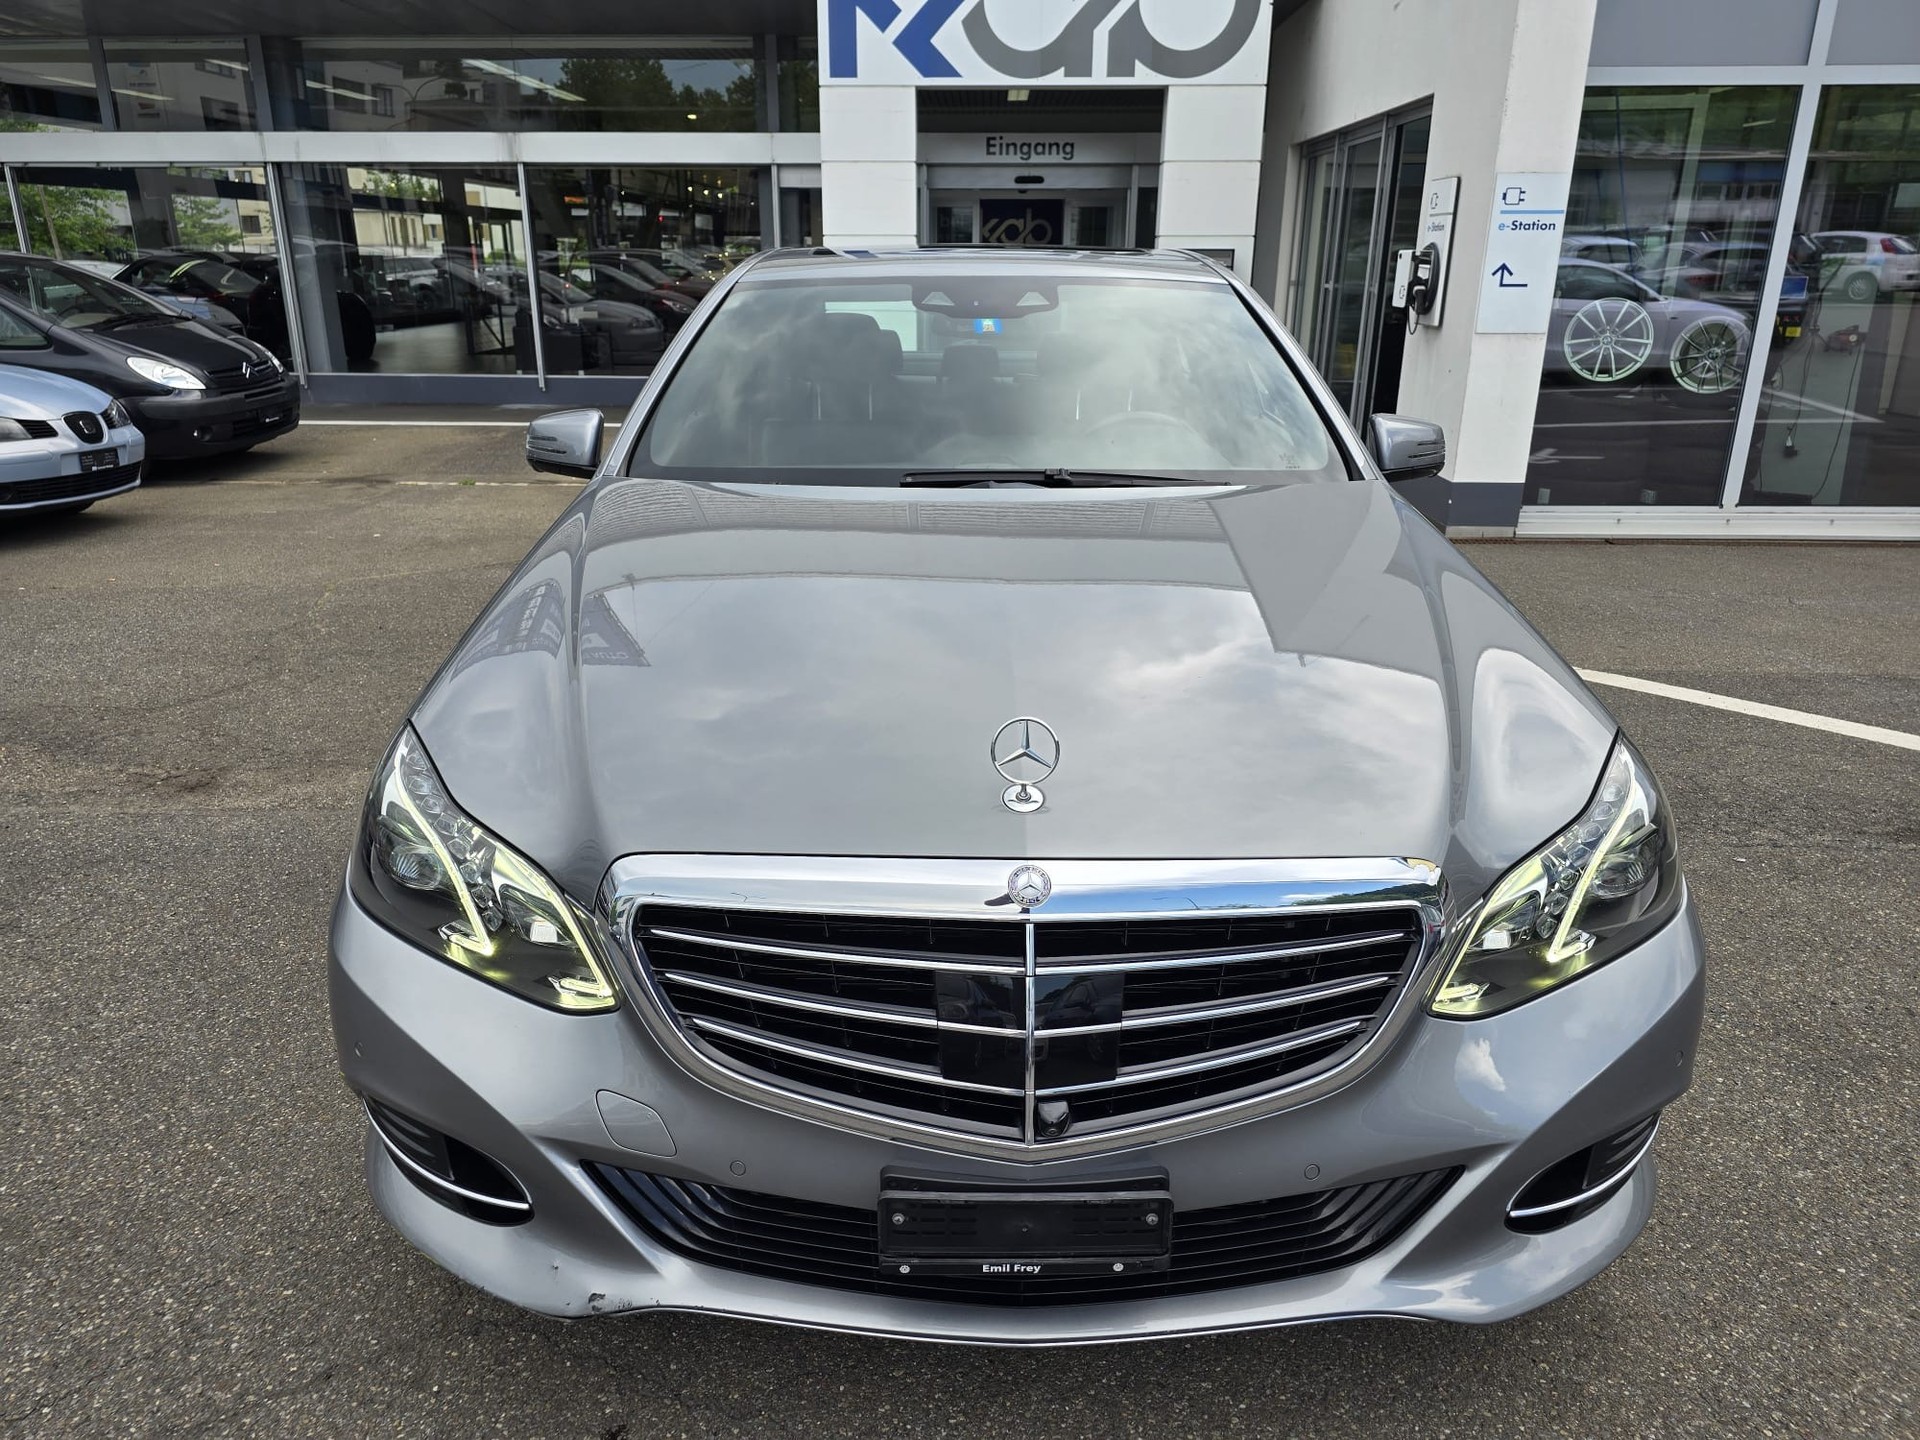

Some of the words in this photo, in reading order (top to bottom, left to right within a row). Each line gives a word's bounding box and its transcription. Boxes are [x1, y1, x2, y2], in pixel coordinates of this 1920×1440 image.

[986, 135, 1075, 160] Eingang
[1498, 220, 1556, 231] e-Station
[982, 1264, 1010, 1273] Emil
[1014, 1264, 1041, 1274] Frey
